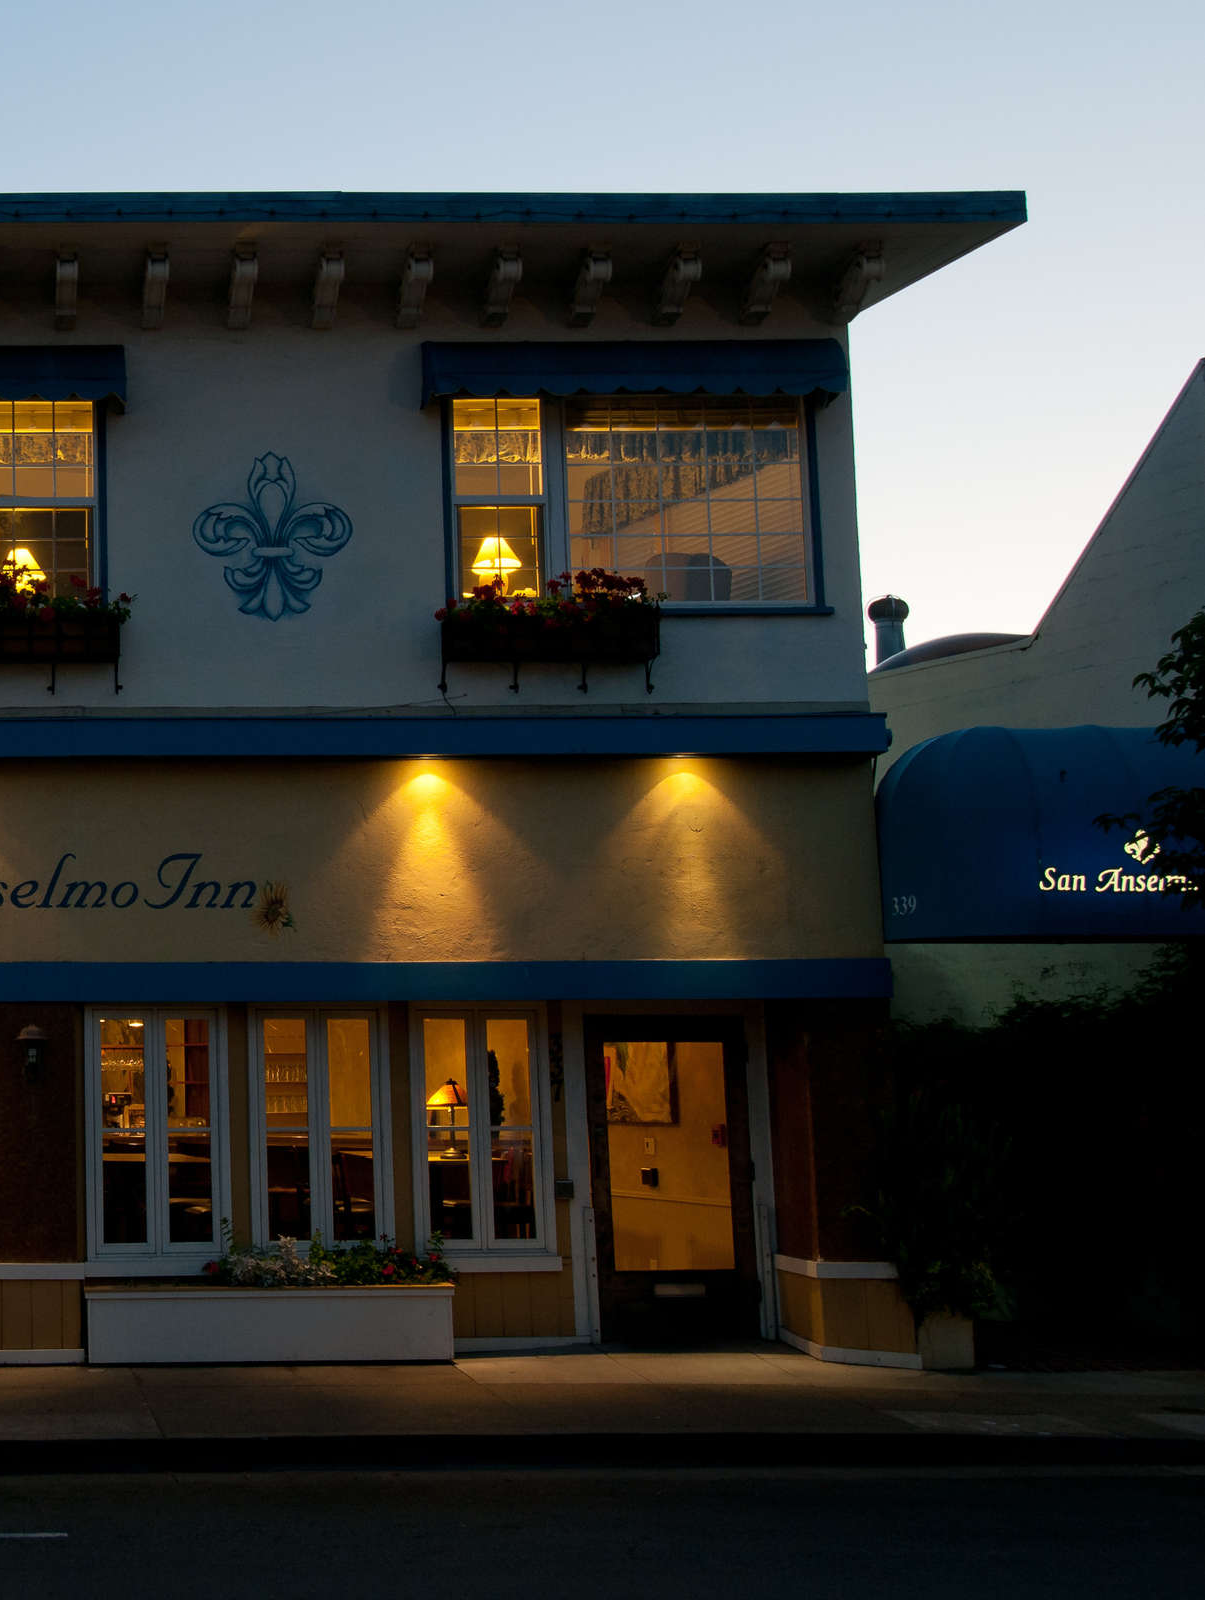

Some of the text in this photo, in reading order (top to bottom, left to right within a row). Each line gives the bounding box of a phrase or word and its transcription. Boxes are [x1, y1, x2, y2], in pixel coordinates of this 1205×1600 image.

[143, 852, 257, 911] Inn
[1039, 867, 1087, 892] San
[892, 893, 917, 916] 339
